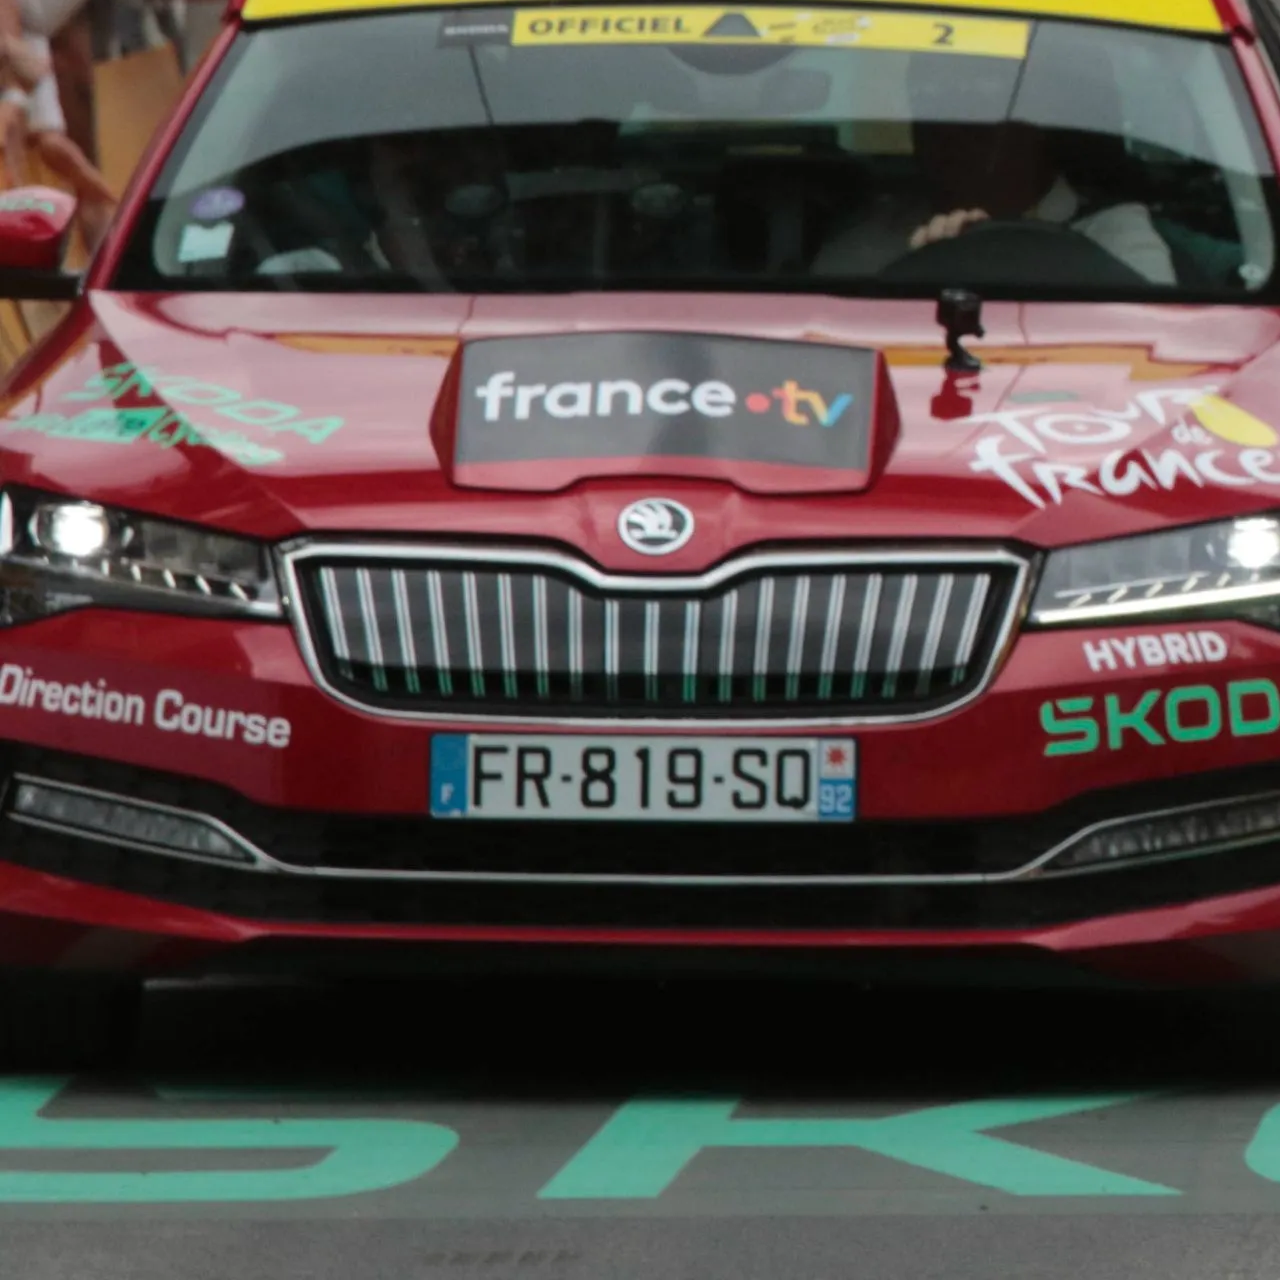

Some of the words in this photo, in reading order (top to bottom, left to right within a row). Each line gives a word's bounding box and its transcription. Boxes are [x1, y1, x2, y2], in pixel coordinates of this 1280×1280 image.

[528, 17, 691, 35] OFFICIEL
[933, 23, 955, 45] 2
[1083, 630, 1227, 672] HYBRID
[154, 689, 292, 748] Course
[820, 784, 852, 813] 92
